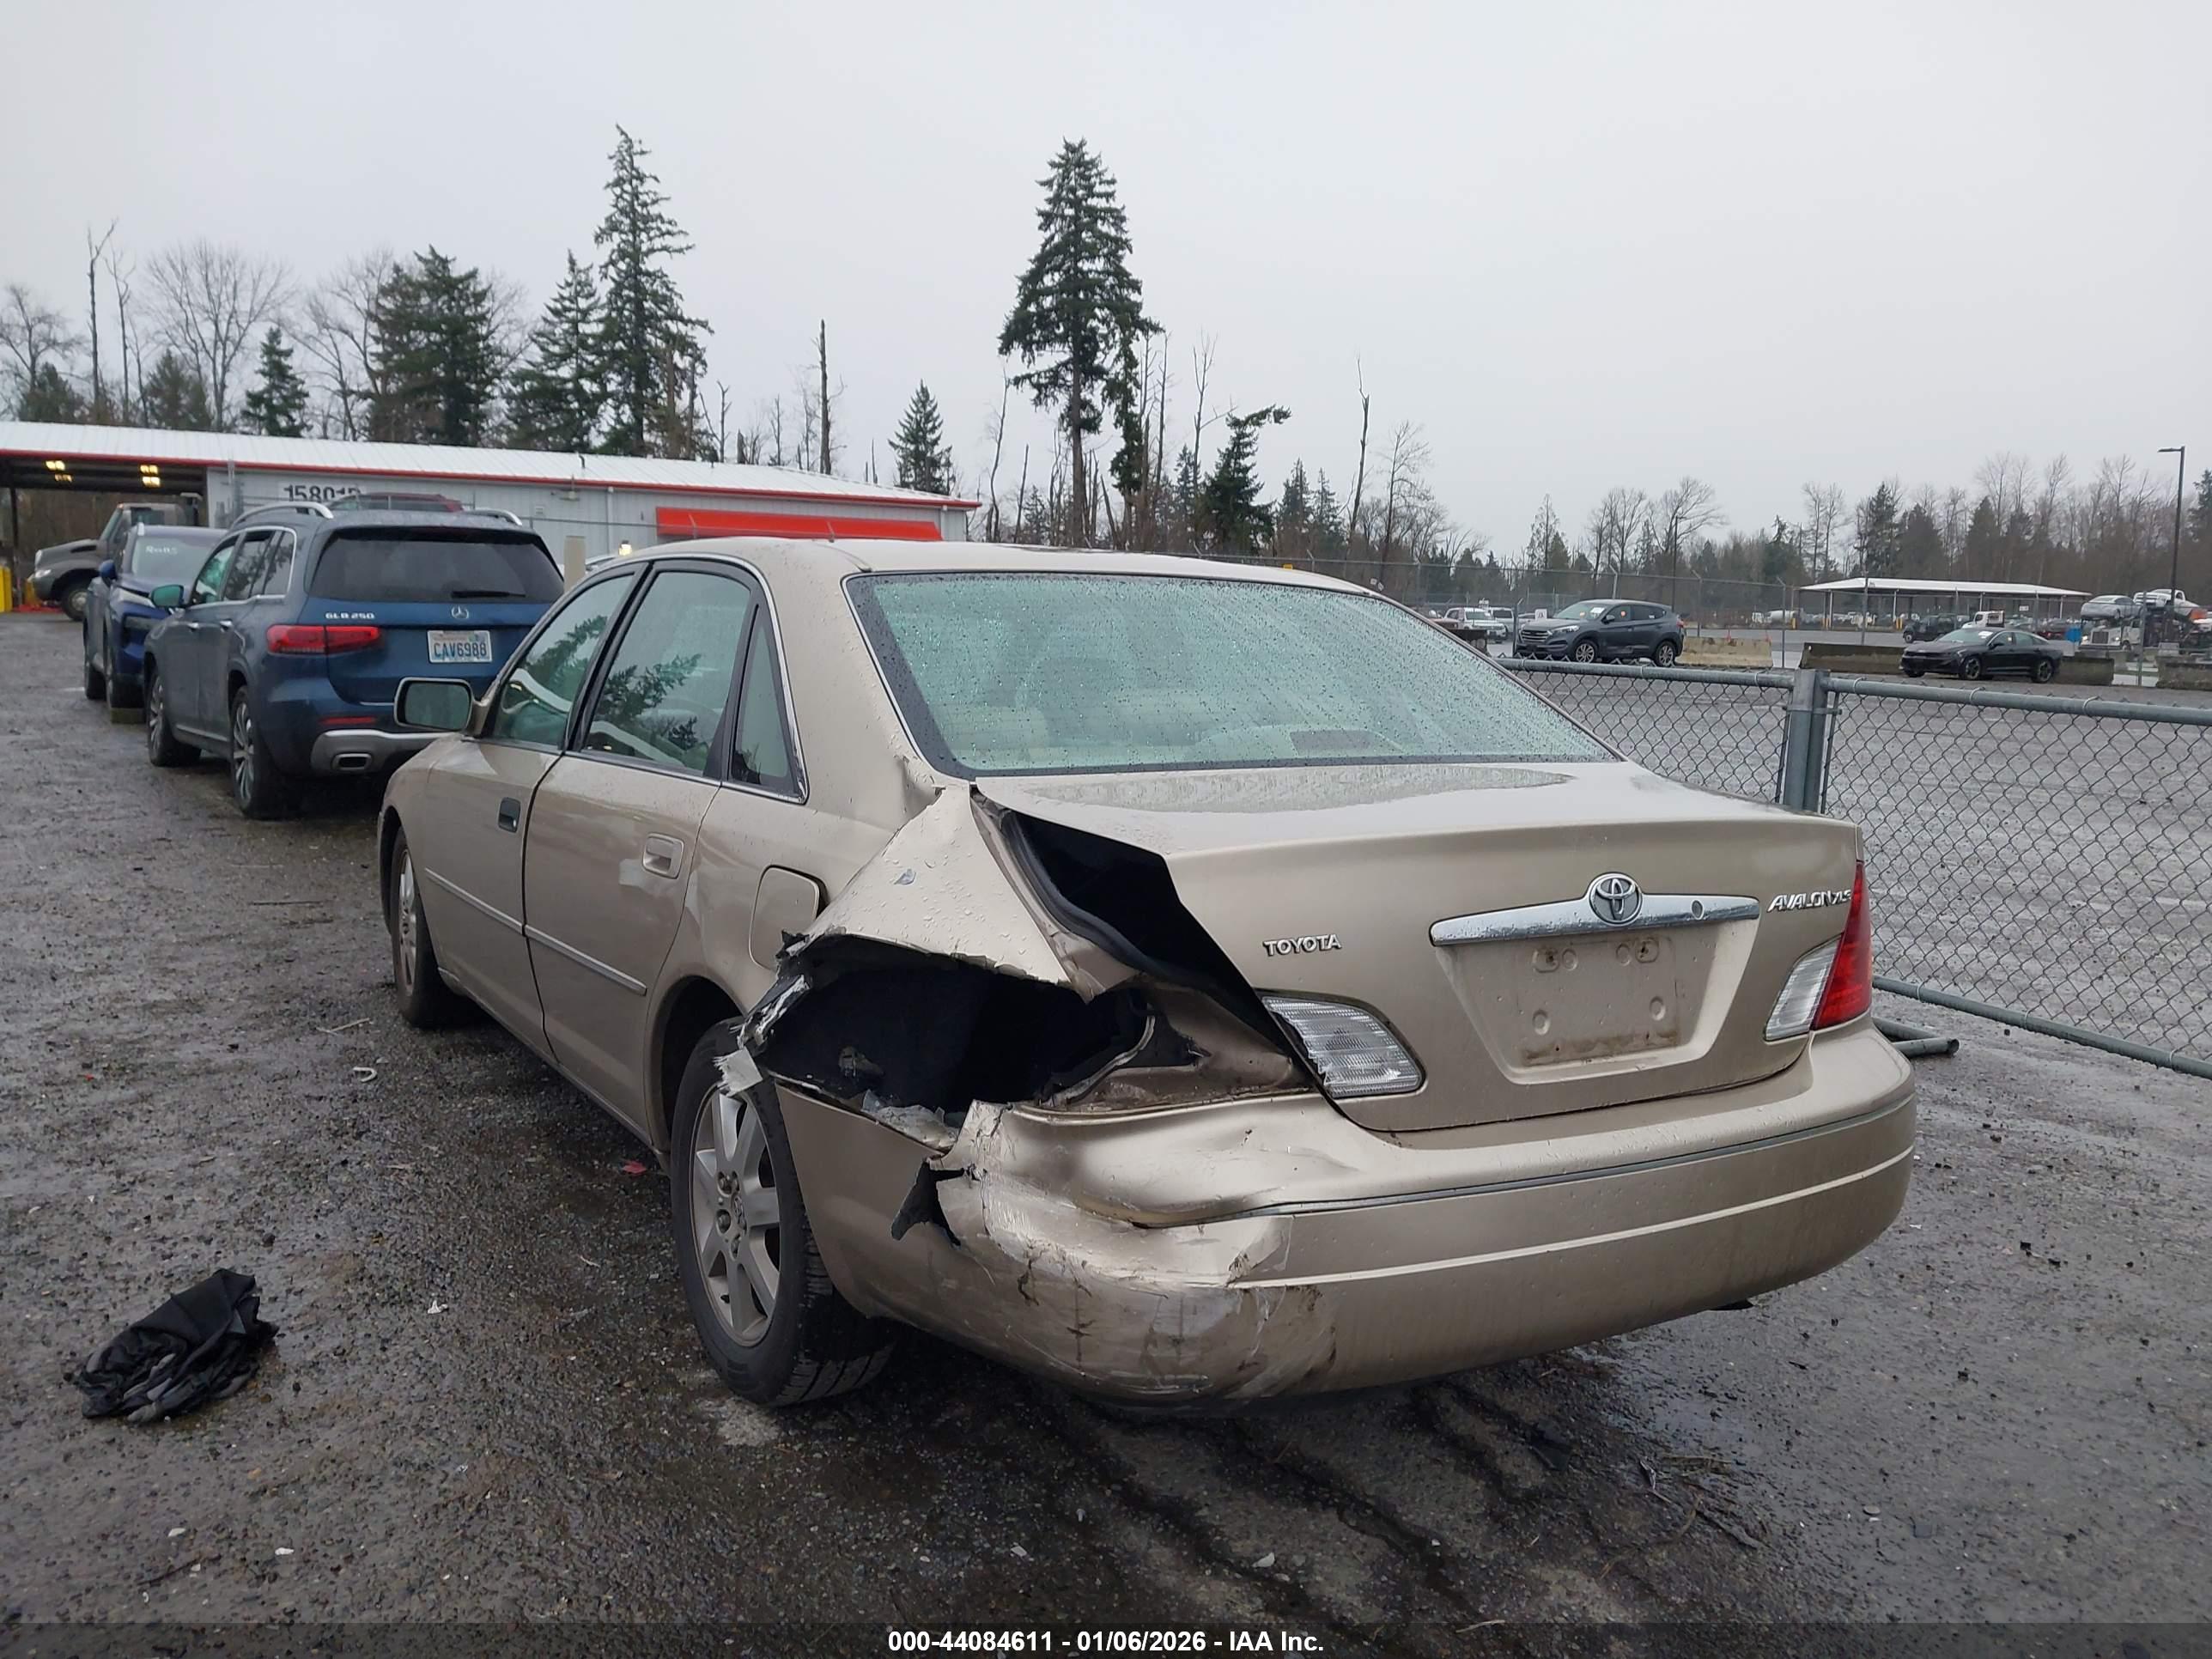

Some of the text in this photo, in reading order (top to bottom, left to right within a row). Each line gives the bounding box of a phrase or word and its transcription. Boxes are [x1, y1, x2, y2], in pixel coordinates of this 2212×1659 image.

[433, 642, 487, 658] CAV6988
[1767, 890, 1832, 912] AVALON
[1262, 934, 1342, 957] TOYOTA
